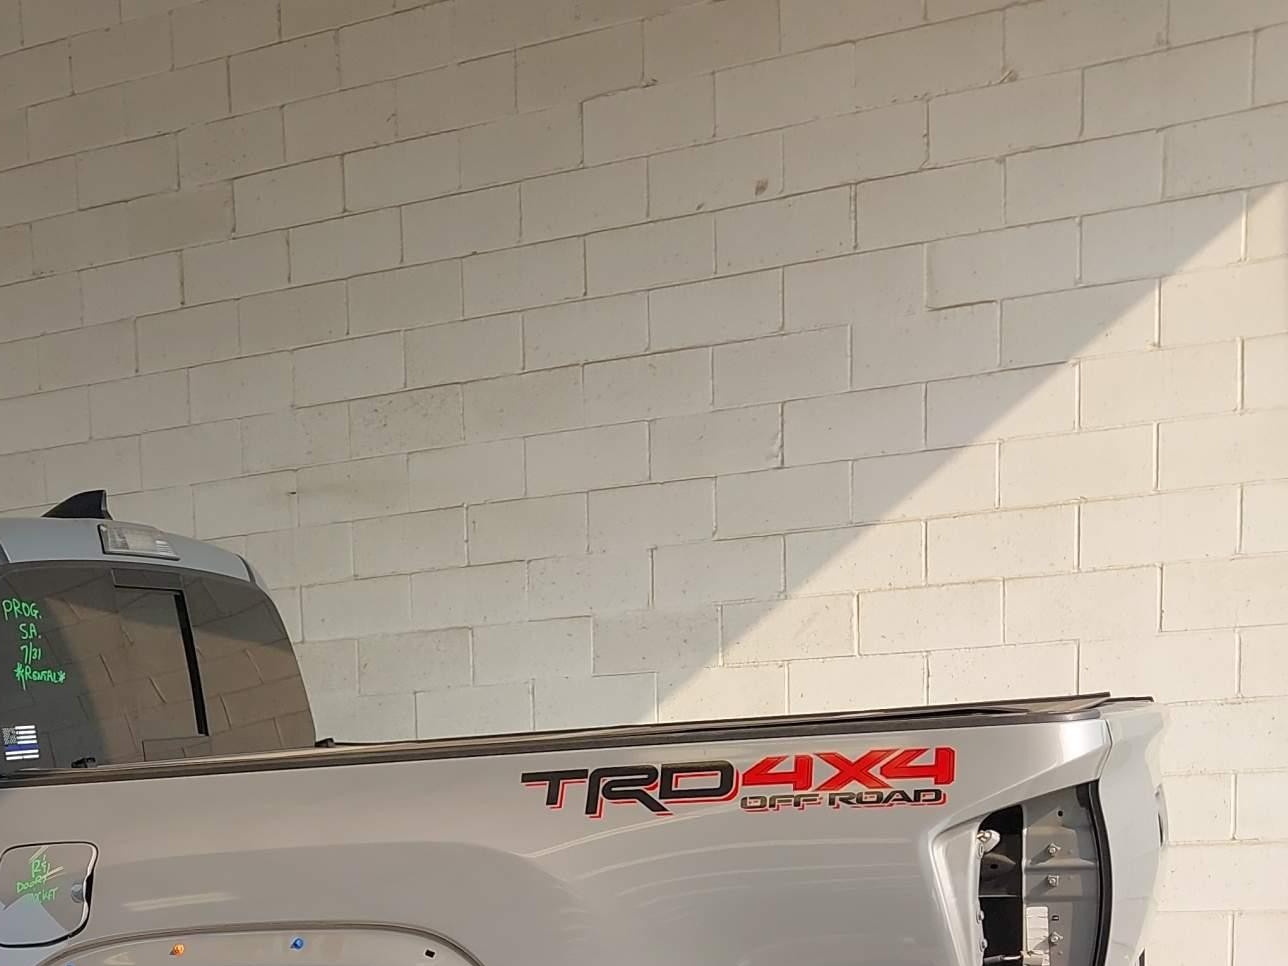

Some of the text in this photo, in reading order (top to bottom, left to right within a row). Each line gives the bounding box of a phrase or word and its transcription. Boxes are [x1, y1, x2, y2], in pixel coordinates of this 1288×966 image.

[520, 746, 957, 819] TRD 4X4
[739, 788, 948, 811] OFF ROAD
